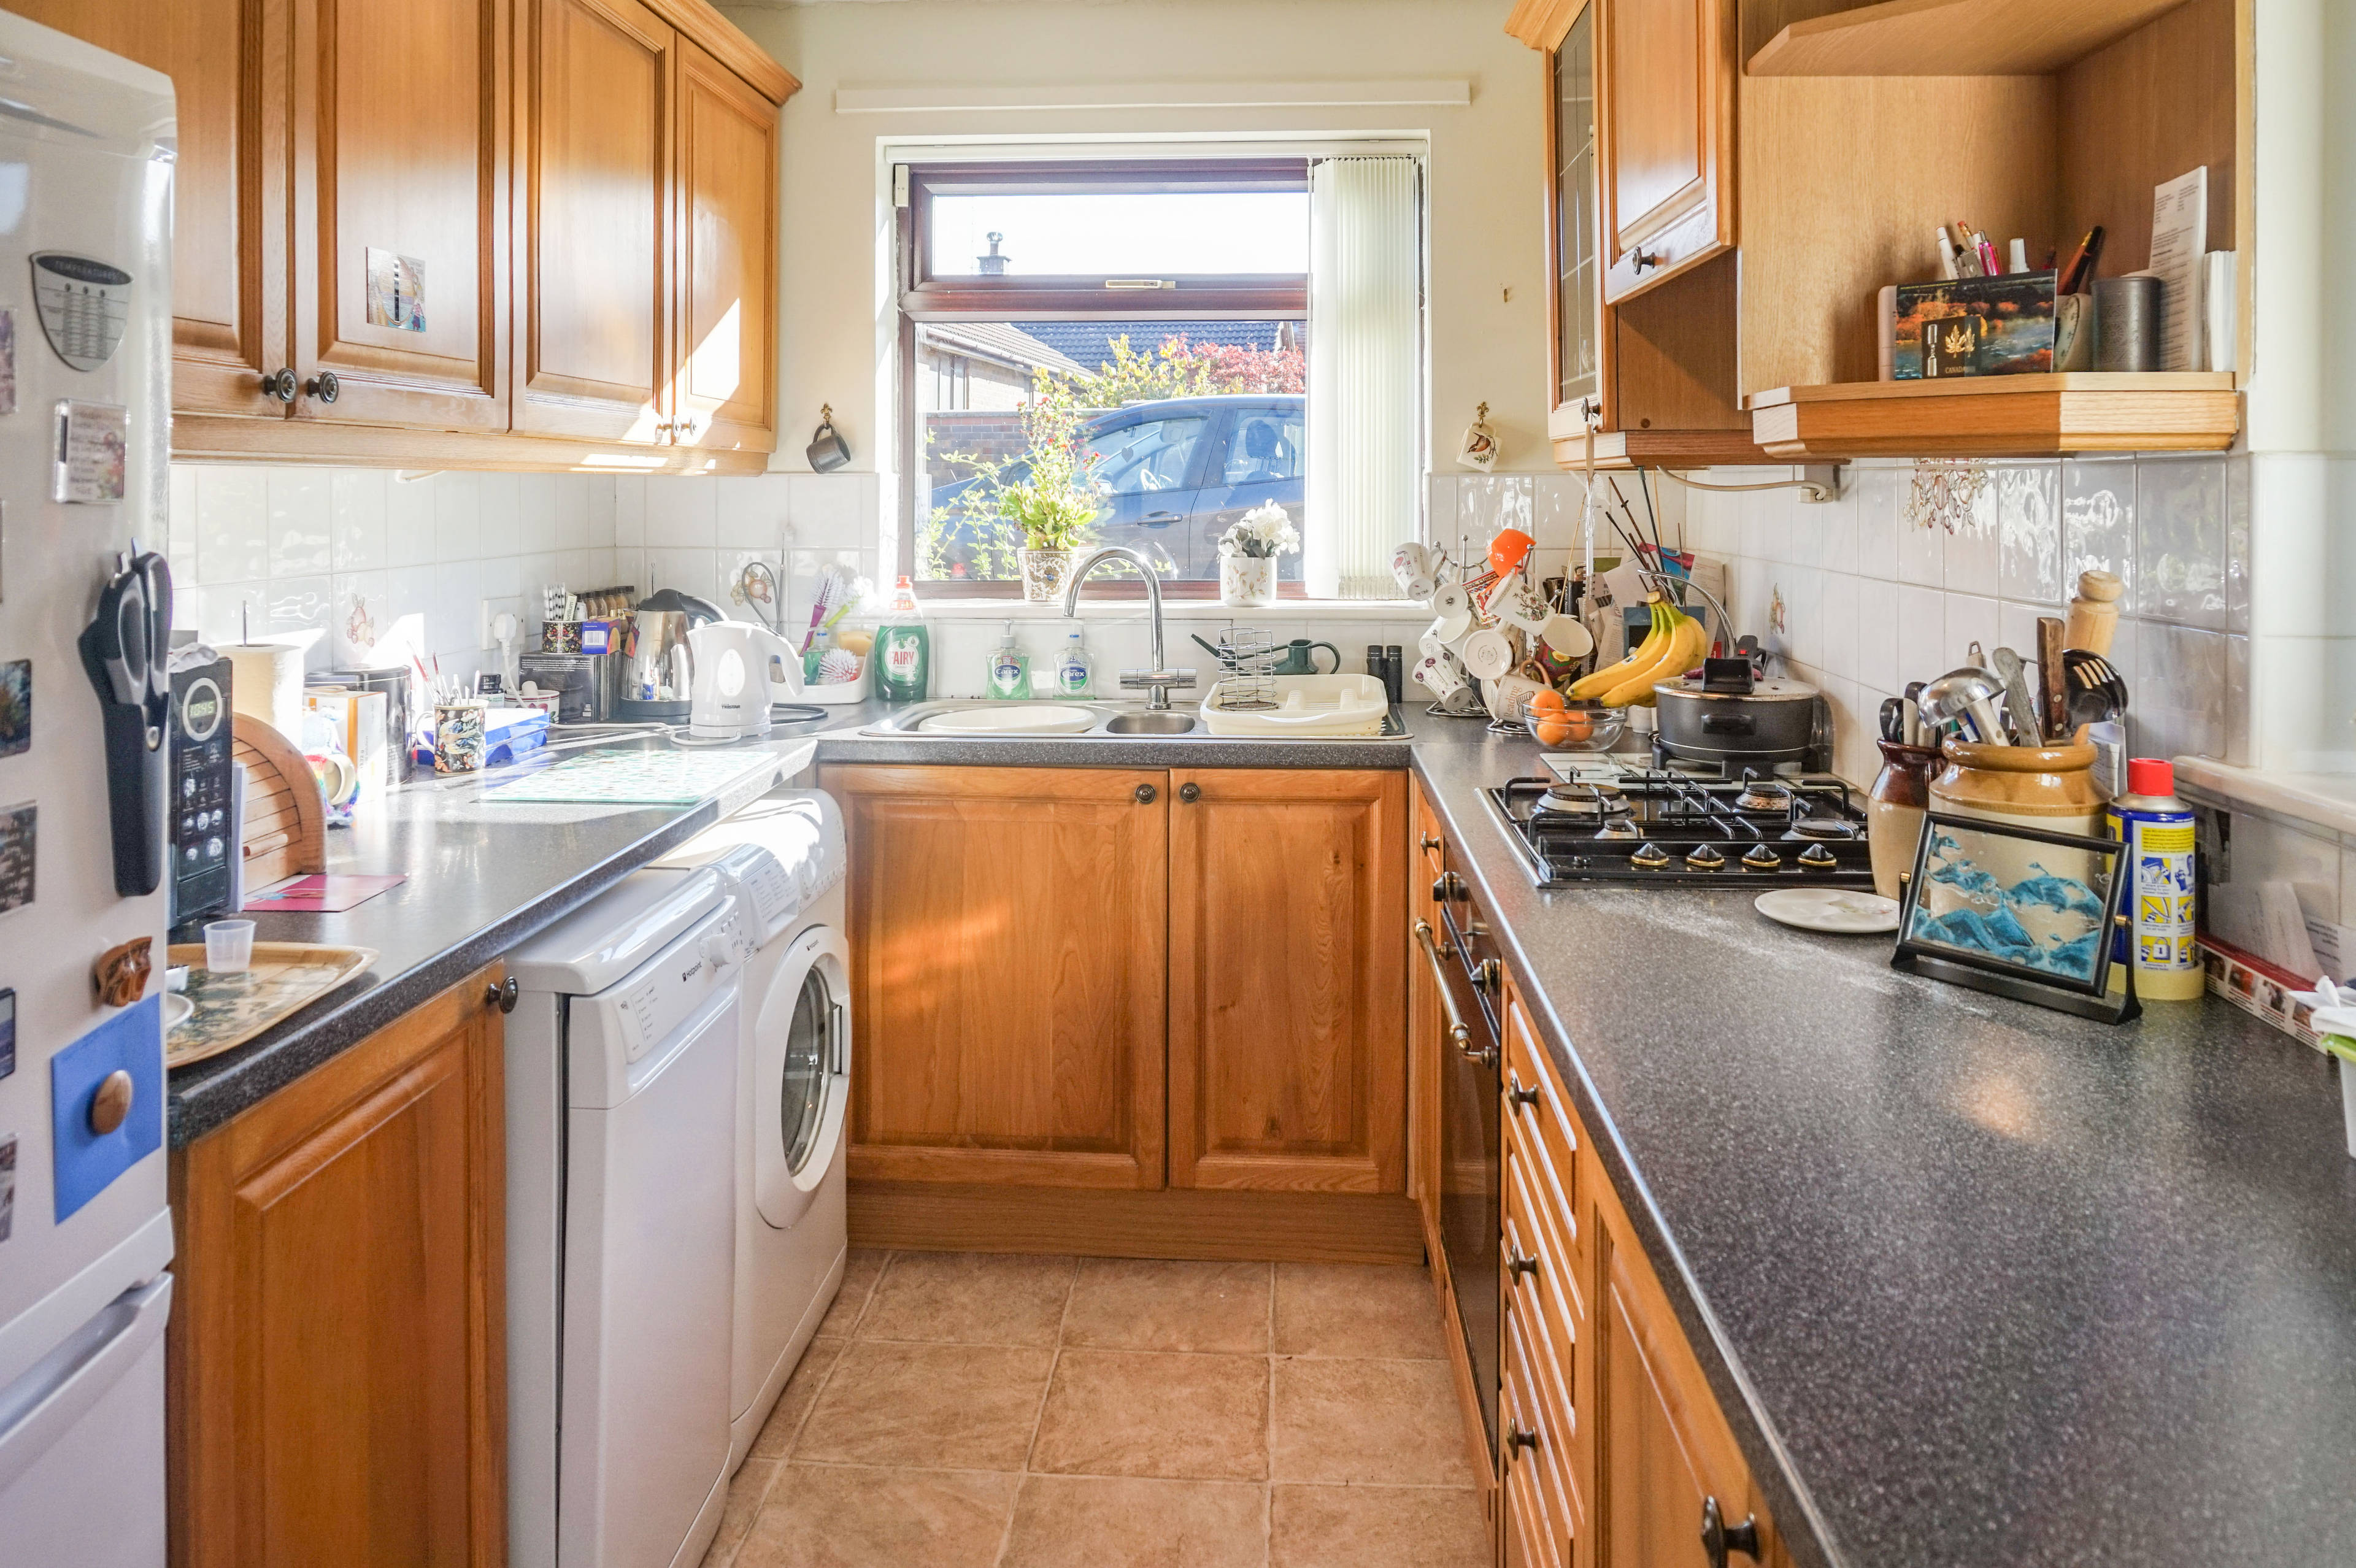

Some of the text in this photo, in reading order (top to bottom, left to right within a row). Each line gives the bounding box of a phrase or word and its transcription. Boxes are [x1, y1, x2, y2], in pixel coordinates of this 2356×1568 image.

[888, 651, 915, 665] FAIRY
[1503, 685, 1522, 717] Reading
[687, 961, 702, 977] Hotpoint
